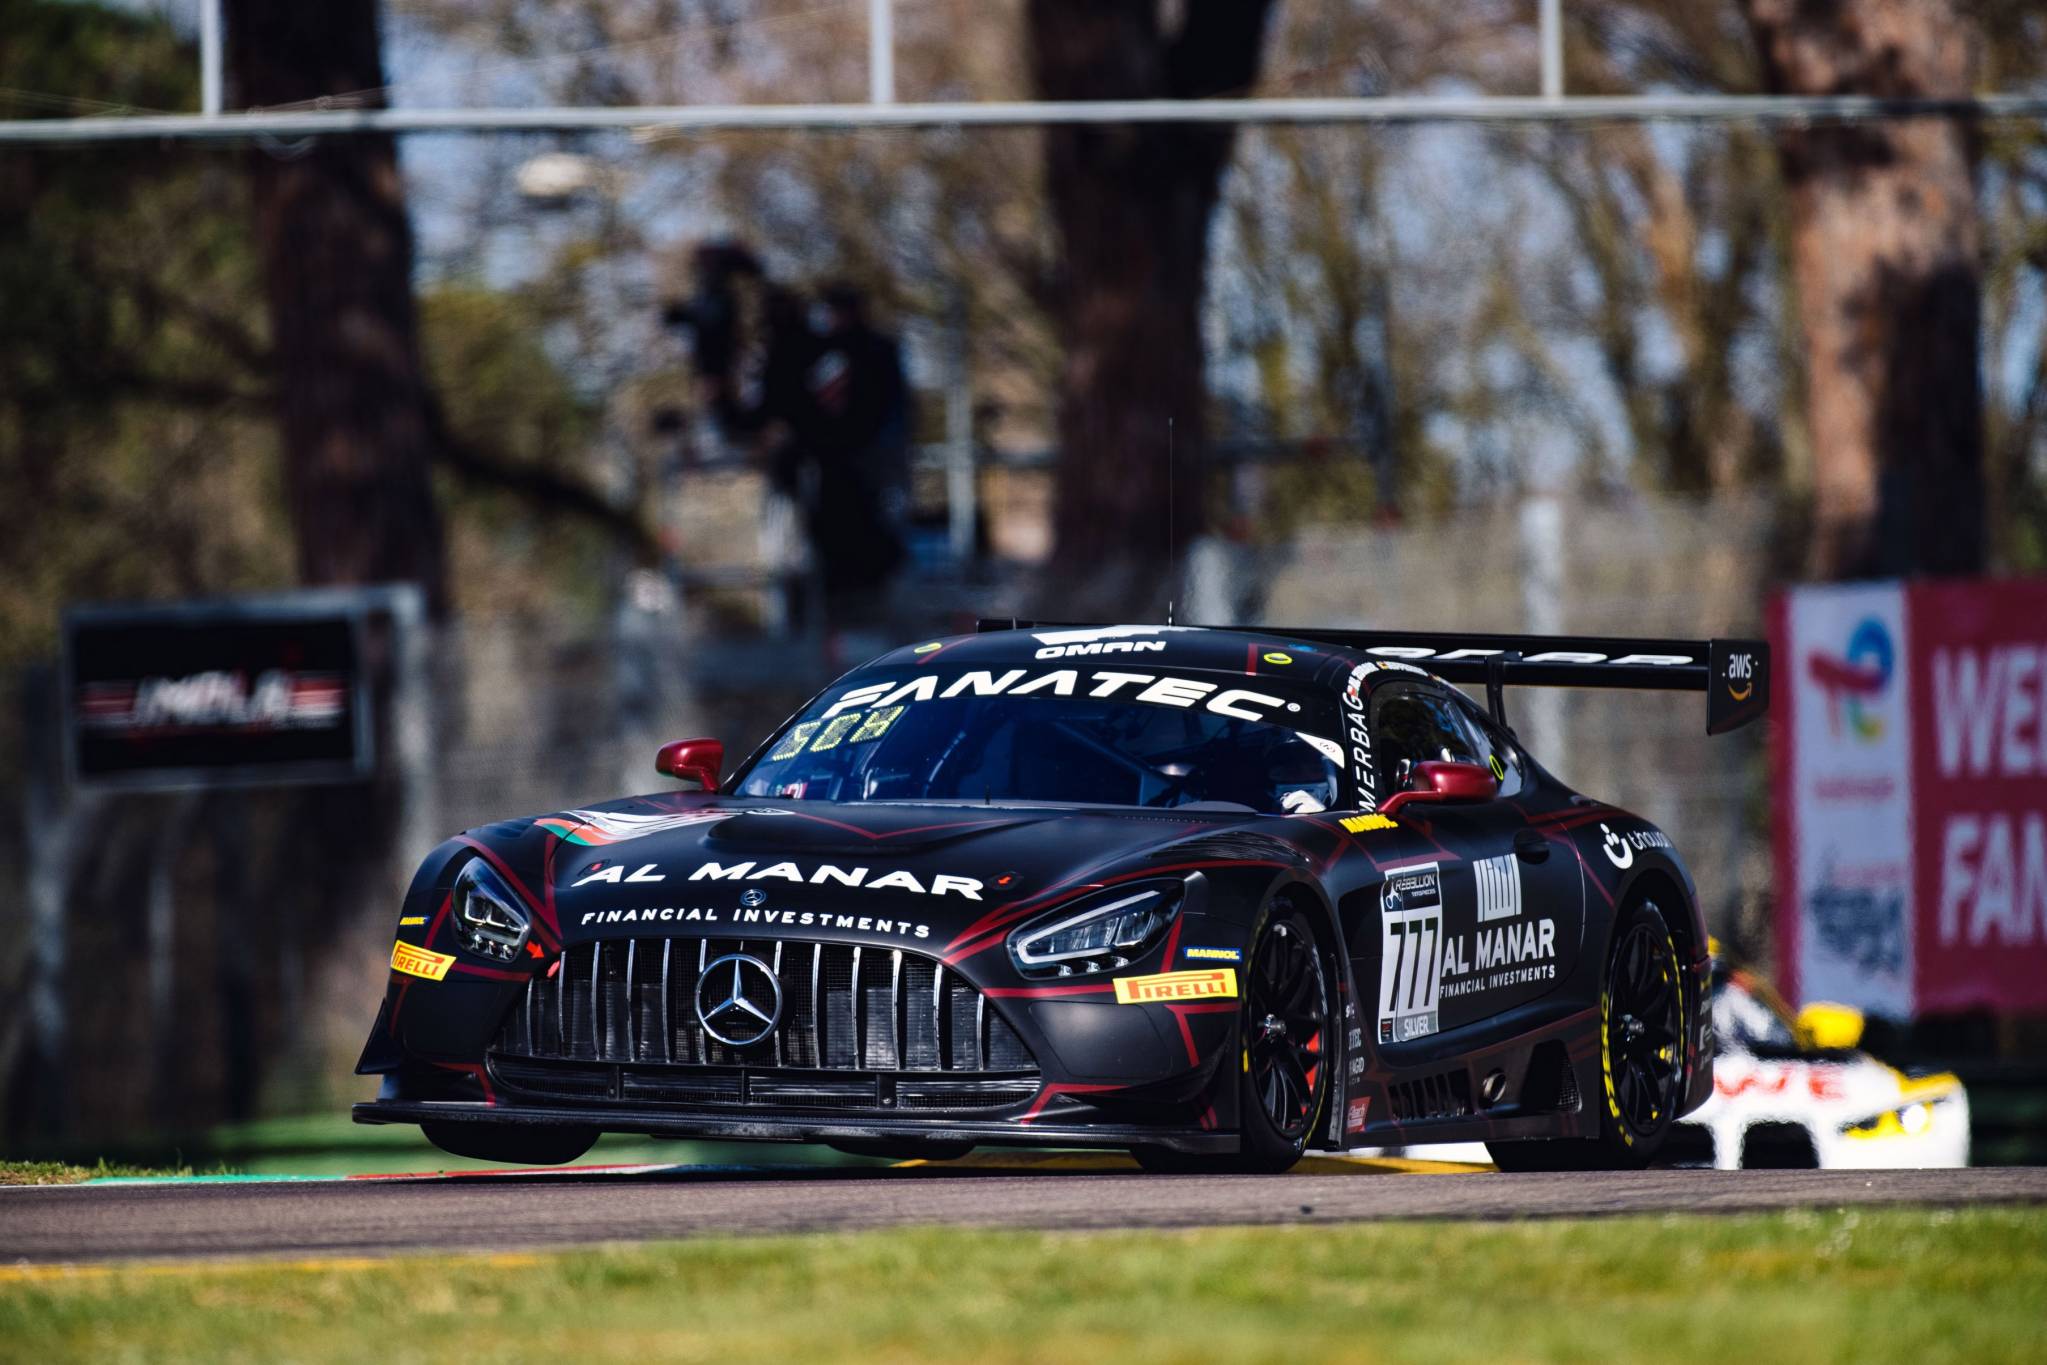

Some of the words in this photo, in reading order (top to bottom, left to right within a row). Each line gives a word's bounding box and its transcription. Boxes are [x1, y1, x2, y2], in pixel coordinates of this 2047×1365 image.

[1035, 641, 1167, 660] OMAN
[1728, 653, 1752, 679] aws
[821, 669, 1286, 722] FANATEC
[1342, 691, 1377, 813] MERBAG
[570, 864, 666, 888] AL
[687, 861, 984, 901] MANAR
[1395, 873, 1436, 891] REBELLION
[580, 907, 718, 926] FINANCIAL
[733, 908, 931, 939] INVESTMENTS
[1389, 916, 1439, 1012] 777
[1440, 935, 1470, 978] AL
[1475, 918, 1556, 971] MANAR
[1126, 972, 1228, 1000] PIRELLI
[1439, 979, 1486, 1000] FINANCIAL
[1489, 964, 1556, 989] INVESTMENTS
[1403, 1015, 1430, 1037] SILVER
